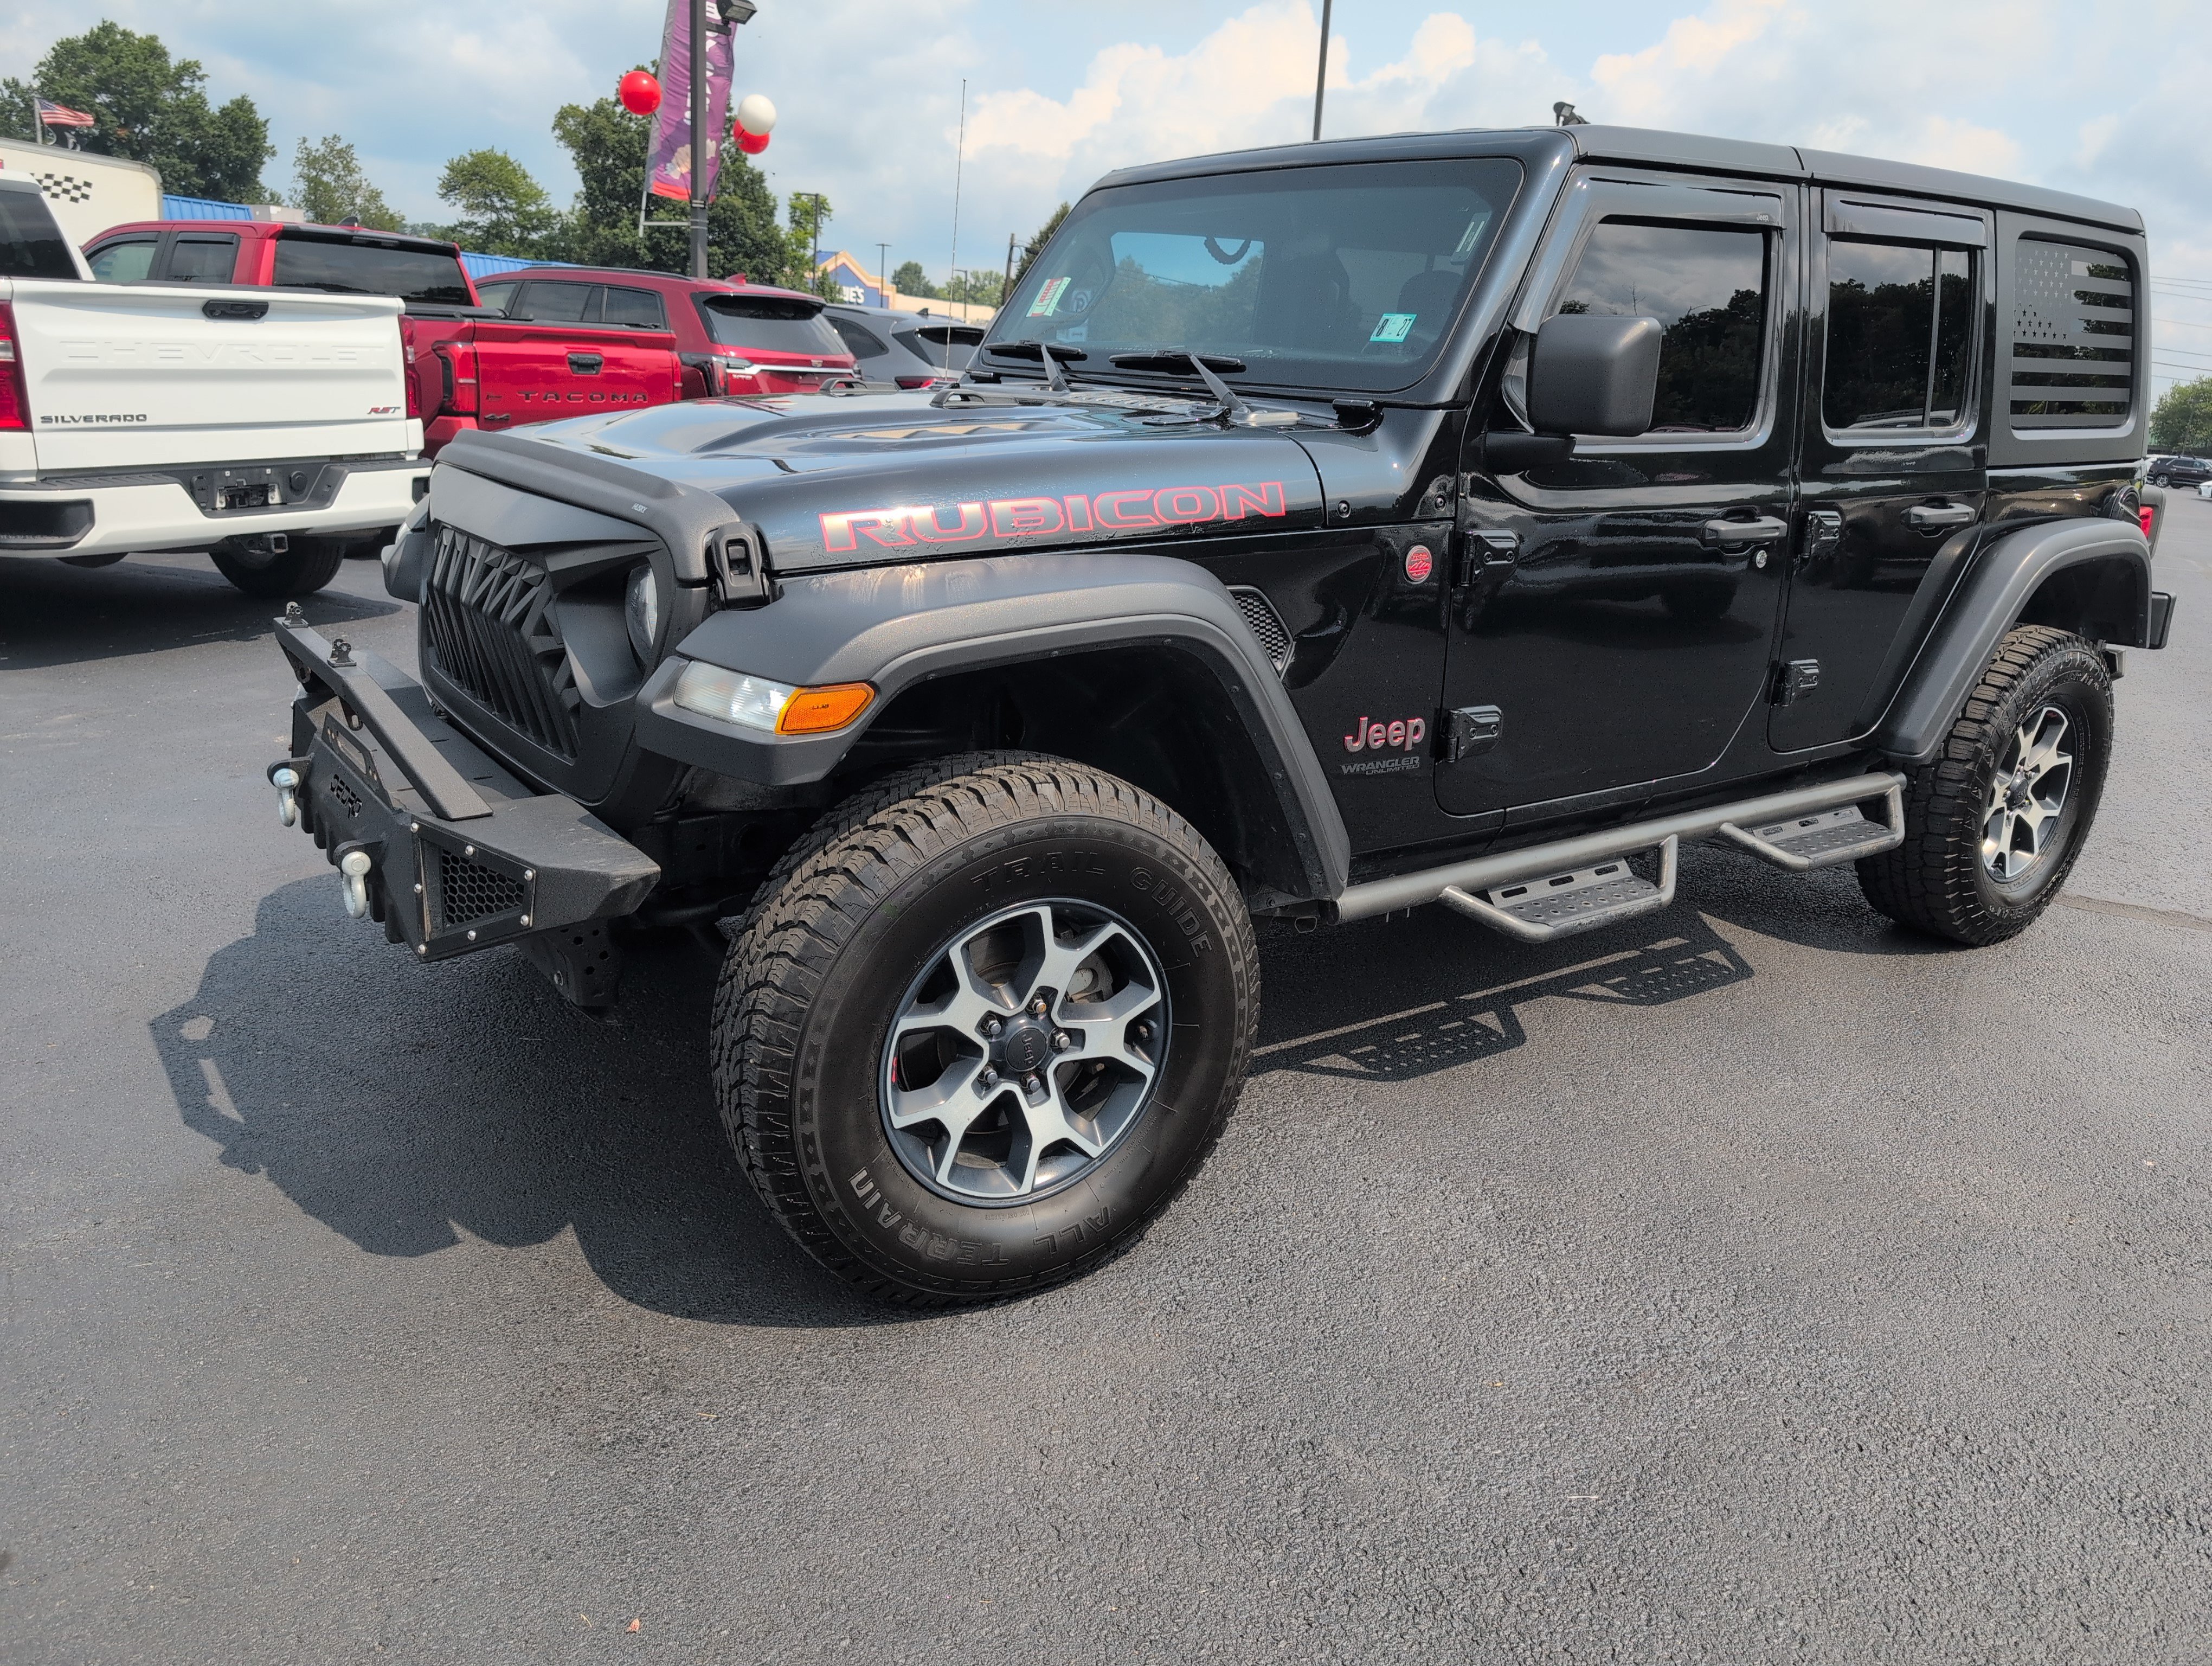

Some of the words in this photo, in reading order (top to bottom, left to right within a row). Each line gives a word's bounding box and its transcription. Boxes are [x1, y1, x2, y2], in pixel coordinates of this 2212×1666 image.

[1757, 213, 1769, 222] Jeep
[59, 341, 385, 363] CHEVROLET
[516, 390, 648, 403] TACOMA
[40, 414, 147, 424] SILVERADO
[367, 406, 401, 414] RST
[819, 482, 1286, 553] RUBICON
[1343, 716, 1426, 752] Jeep
[1341, 756, 1420, 775] WRANGLER
[1365, 764, 1420, 776] UNLIMITED
[970, 851, 1106, 892] TRAIL
[1130, 867, 1213, 958] GUIDE
[847, 1166, 1011, 1267] TERRAIN
[1032, 1204, 1113, 1255] ALL
